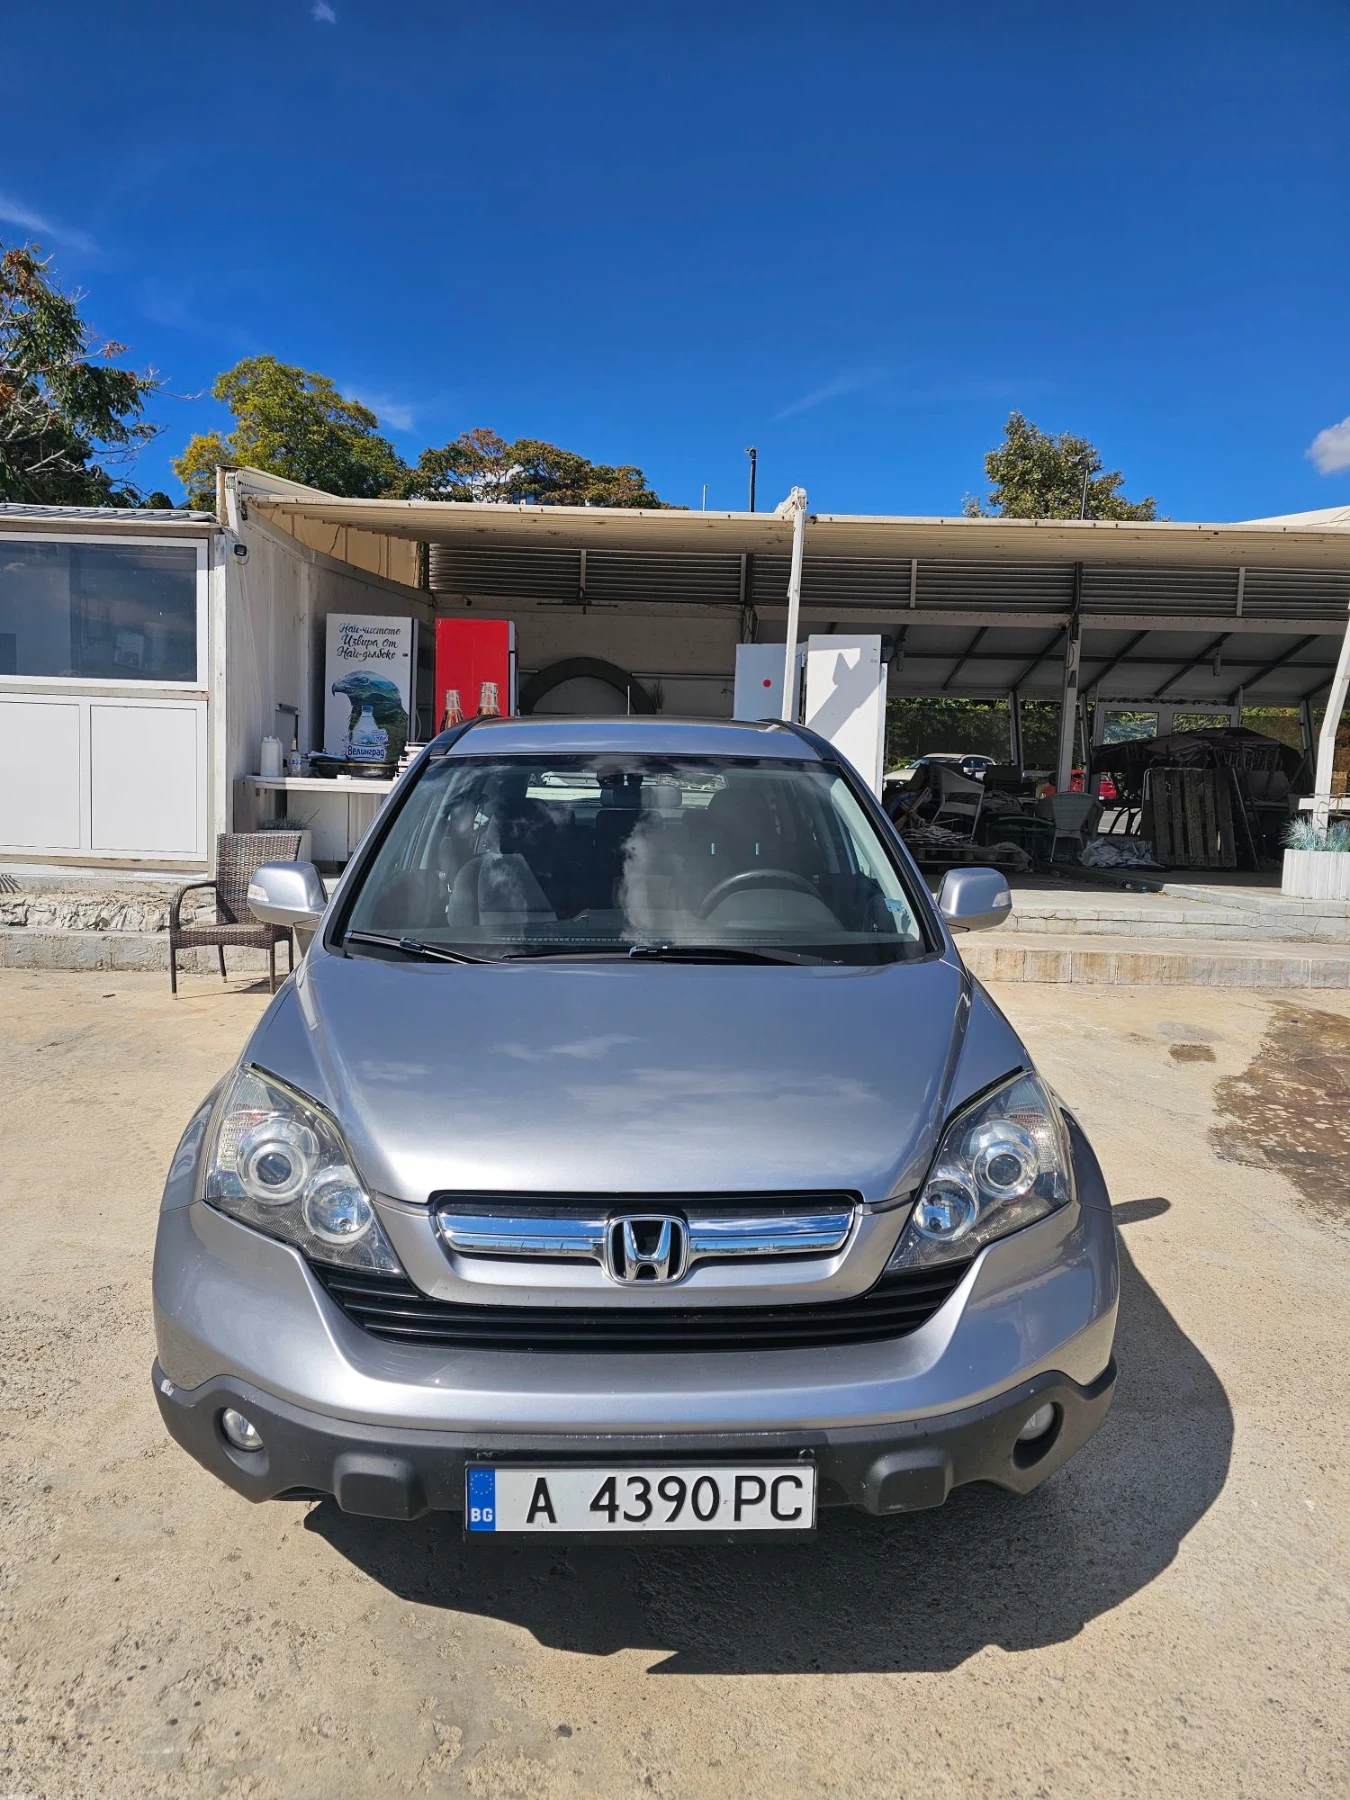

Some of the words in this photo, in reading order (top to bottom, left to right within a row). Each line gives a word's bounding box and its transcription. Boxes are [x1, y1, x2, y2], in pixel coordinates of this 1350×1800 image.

[347, 745, 385, 759] Велинград
[526, 1477, 557, 1524] A
[470, 1508, 493, 1522] BG
